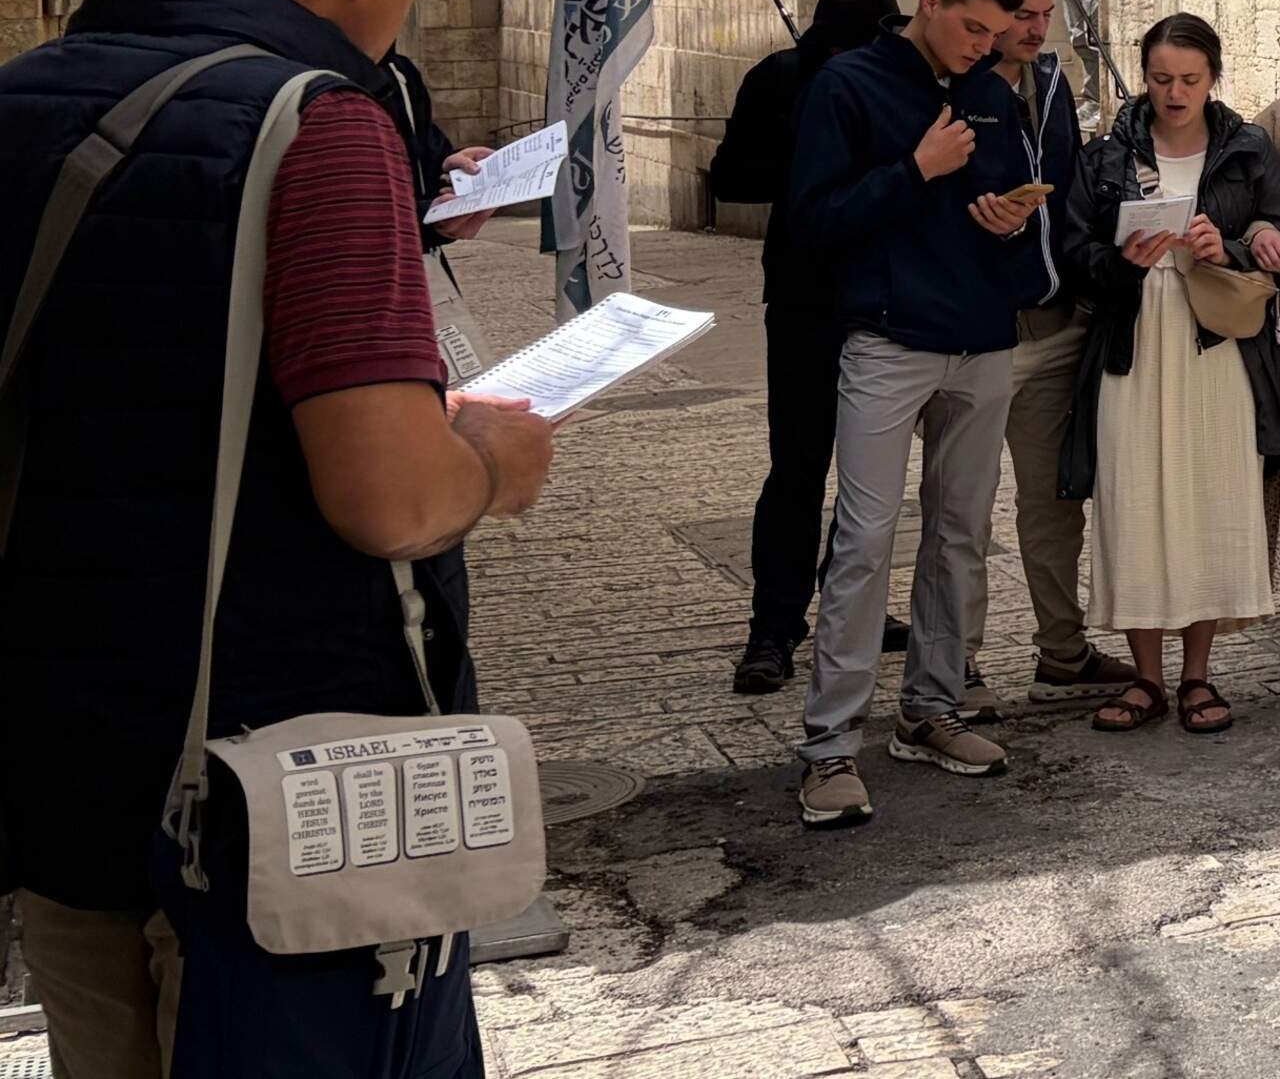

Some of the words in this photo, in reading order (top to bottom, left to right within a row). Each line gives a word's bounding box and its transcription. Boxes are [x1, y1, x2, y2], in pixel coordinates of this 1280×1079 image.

[324, 740, 396, 761] ISRAEL
[360, 799, 384, 810] LORD
[359, 809, 386, 819] JESUS
[300, 818, 328, 829] JESUS
[357, 819, 388, 830] CHRIST
[291, 827, 336, 840] CHRISTUS
